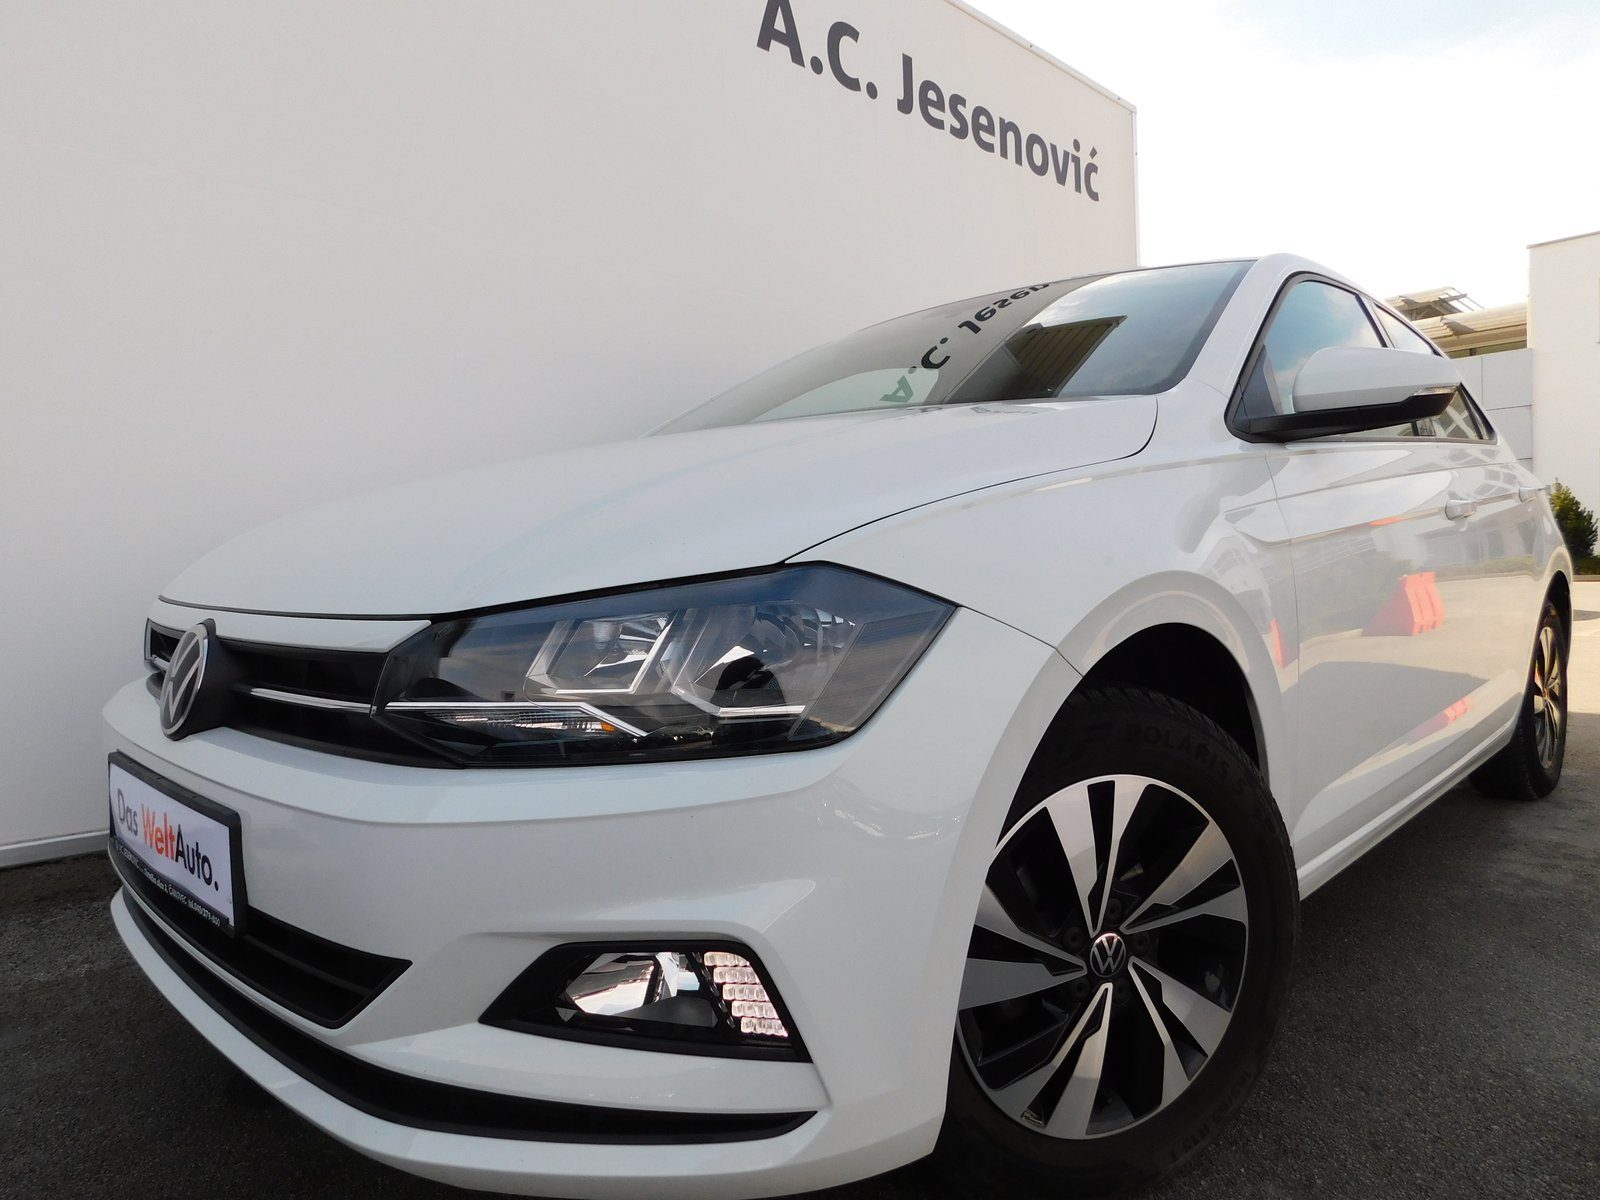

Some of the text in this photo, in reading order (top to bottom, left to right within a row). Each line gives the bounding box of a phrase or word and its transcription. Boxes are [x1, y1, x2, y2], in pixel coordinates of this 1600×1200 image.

[757, 0, 1099, 201] A.C. Jesenović
[117, 787, 139, 836] Das
[141, 802, 220, 892] WeltAuto.
